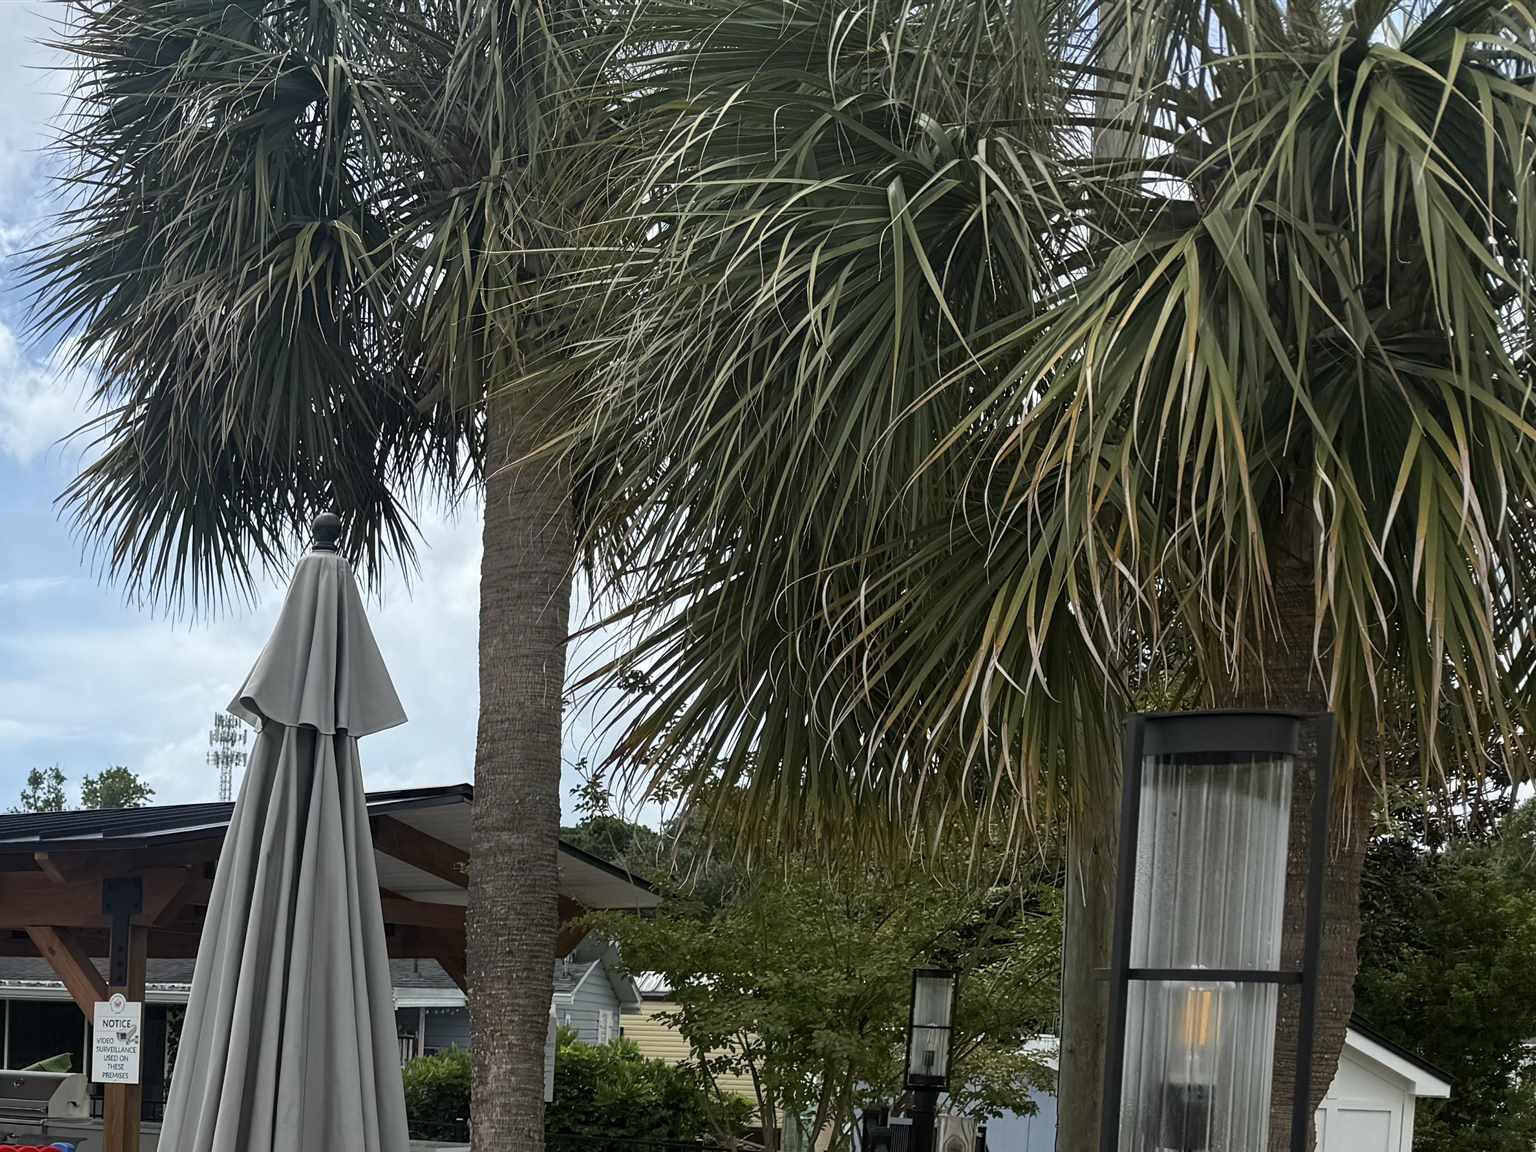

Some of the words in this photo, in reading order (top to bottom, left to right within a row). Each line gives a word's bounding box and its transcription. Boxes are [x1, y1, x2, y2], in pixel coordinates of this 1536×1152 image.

[103, 1019, 131, 1028] NOTICE
[96, 1046, 137, 1054] SURVEILLANCE
[102, 1071, 129, 1079] PREMISES
